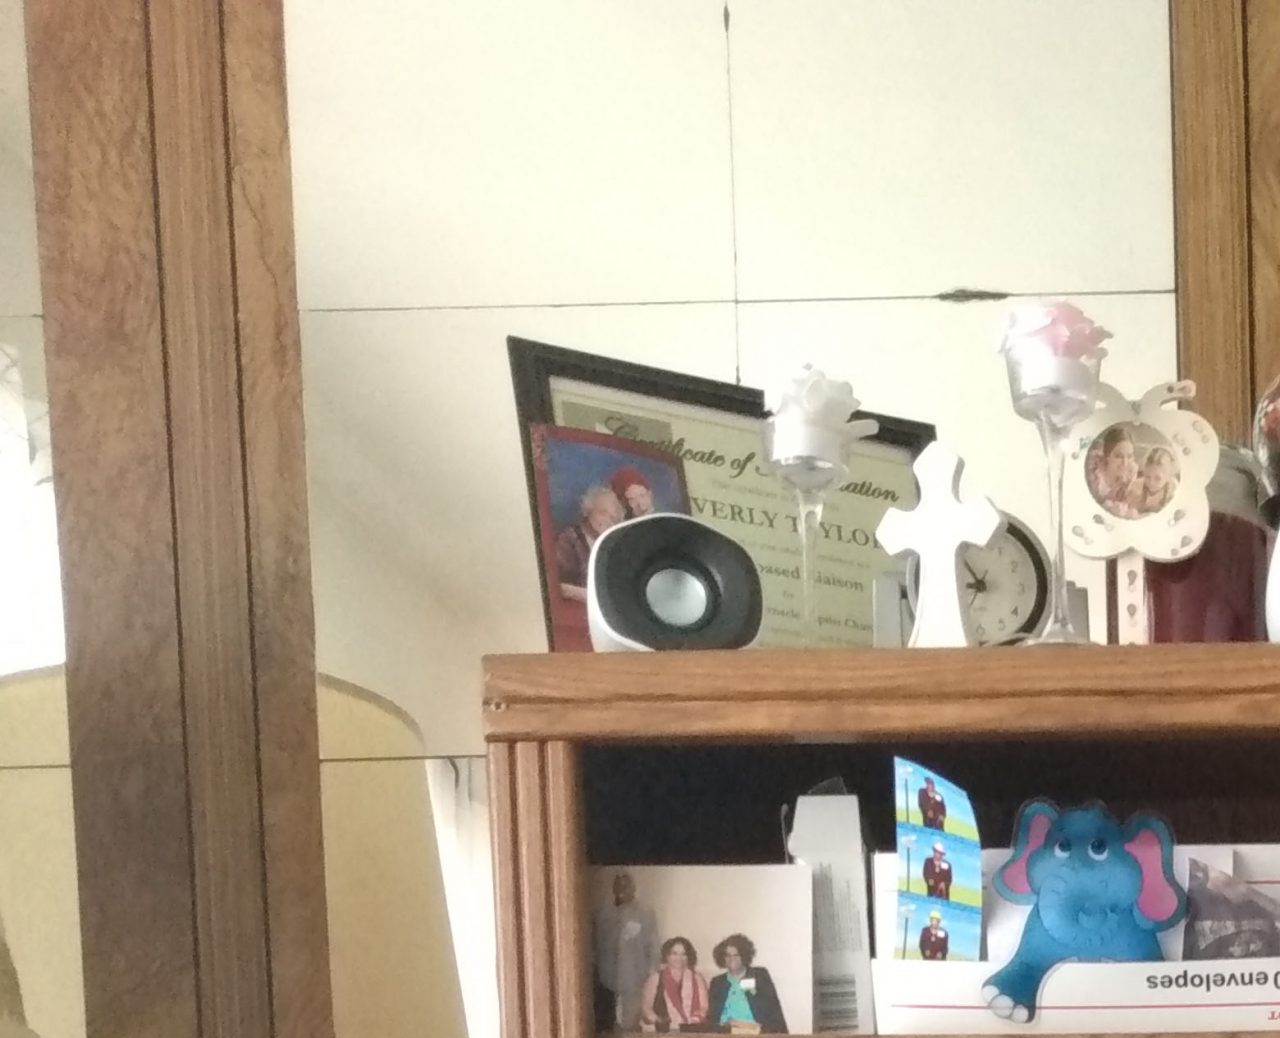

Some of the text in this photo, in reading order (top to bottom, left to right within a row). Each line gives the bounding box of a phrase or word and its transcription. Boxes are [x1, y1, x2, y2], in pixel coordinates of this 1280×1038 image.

[604, 415, 727, 468] Cicate
[729, 451, 757, 479] of
[690, 496, 779, 529] VERLY
[785, 514, 881, 549] TYLO
[1145, 969, 1269, 992] envelopes
